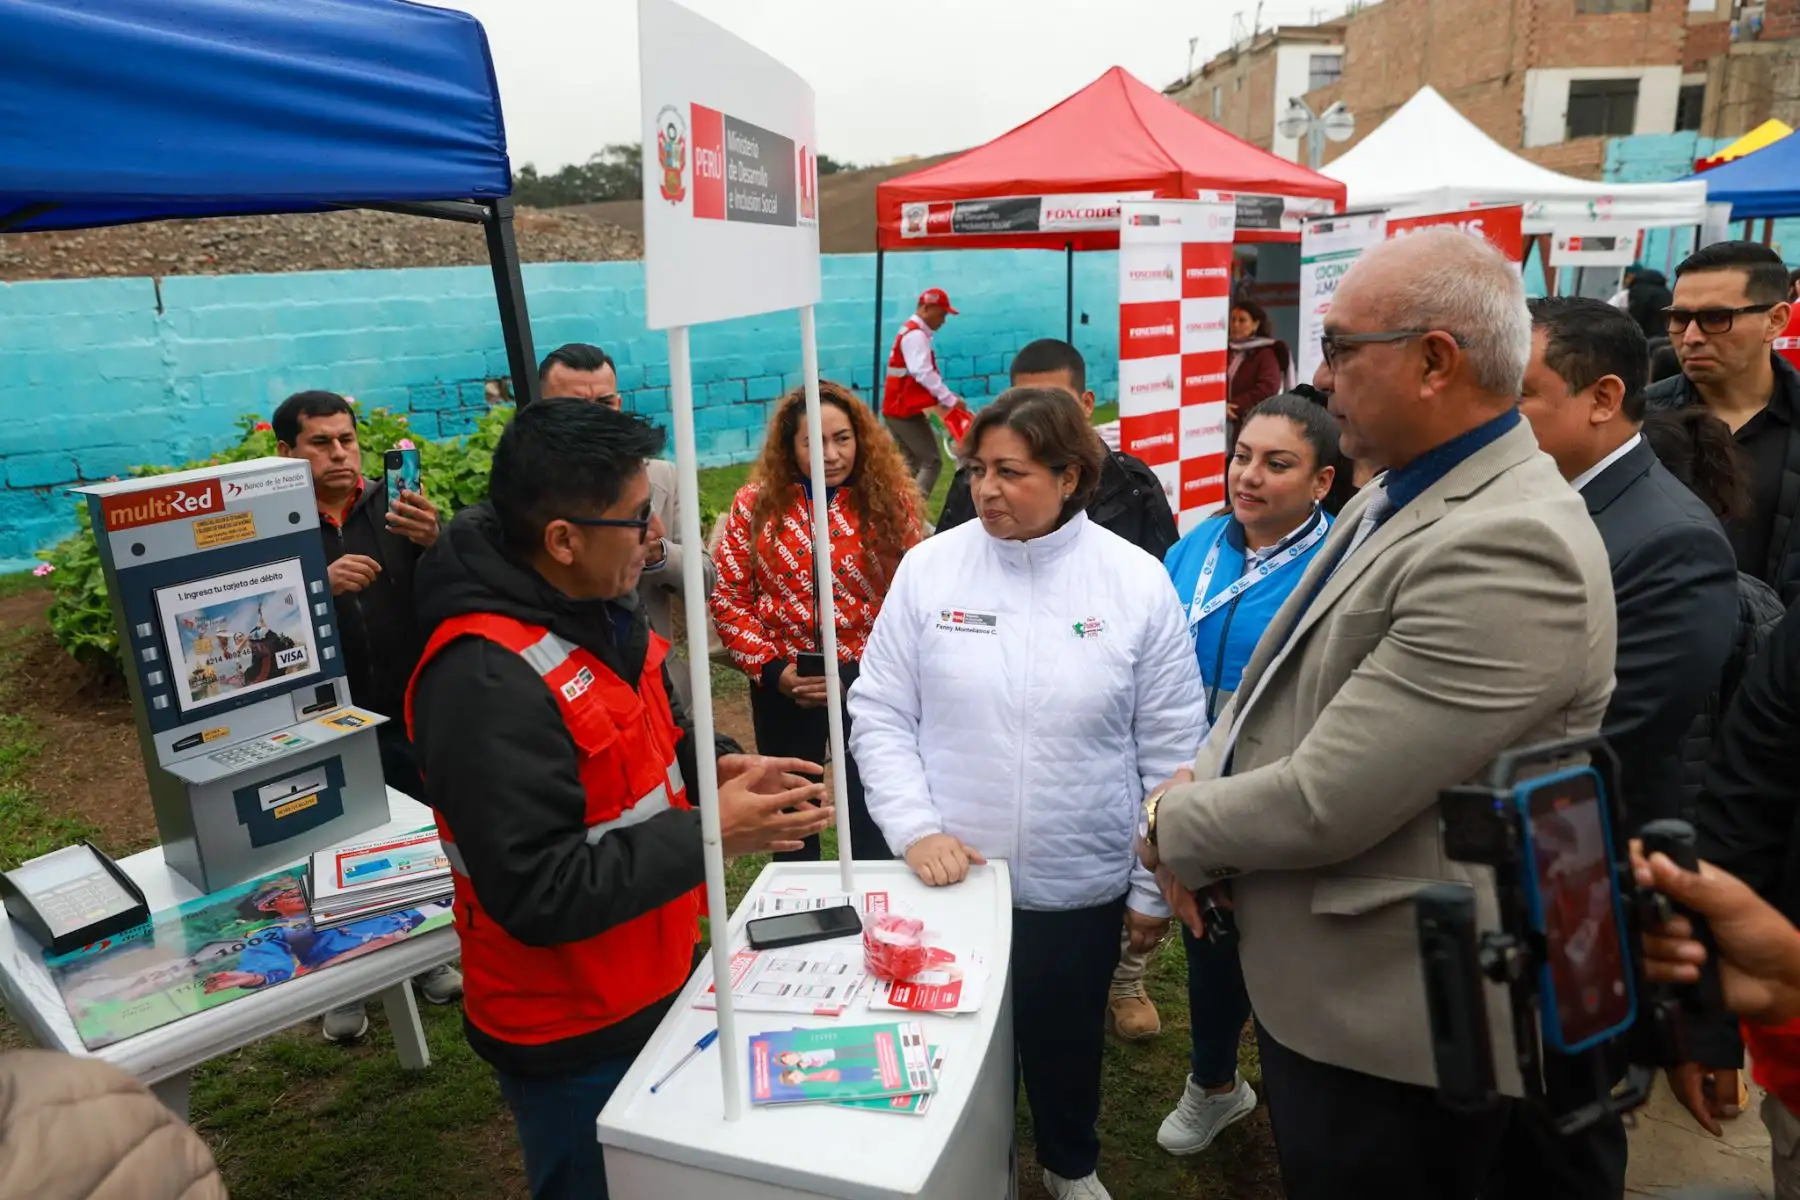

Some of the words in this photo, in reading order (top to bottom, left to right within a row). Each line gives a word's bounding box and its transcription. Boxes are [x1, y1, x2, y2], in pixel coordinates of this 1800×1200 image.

[727, 129, 760, 160] Ministerio
[695, 144, 722, 180] PERÚ
[728, 158, 738, 182] de
[738, 160, 768, 188] Desarrollo
[728, 191, 735, 209] e
[735, 188, 762, 213] Inclusión
[761, 191, 778, 214] Social
[244, 481, 263, 491] Banco
[265, 479, 273, 487] de
[274, 477, 281, 485] la
[283, 473, 303, 483] Nación
[111, 487, 212, 525] multiRed
[185, 588, 213, 600] Ingresa
[215, 584, 223, 594] tu
[223, 579, 248, 591] tarjeta
[250, 576, 258, 586] de
[260, 573, 283, 583] débito
[841, 554, 876, 602] Supreme
[774, 574, 810, 620] Supreme
[280, 649, 304, 664] VISA
[215, 931, 281, 957] 1002
